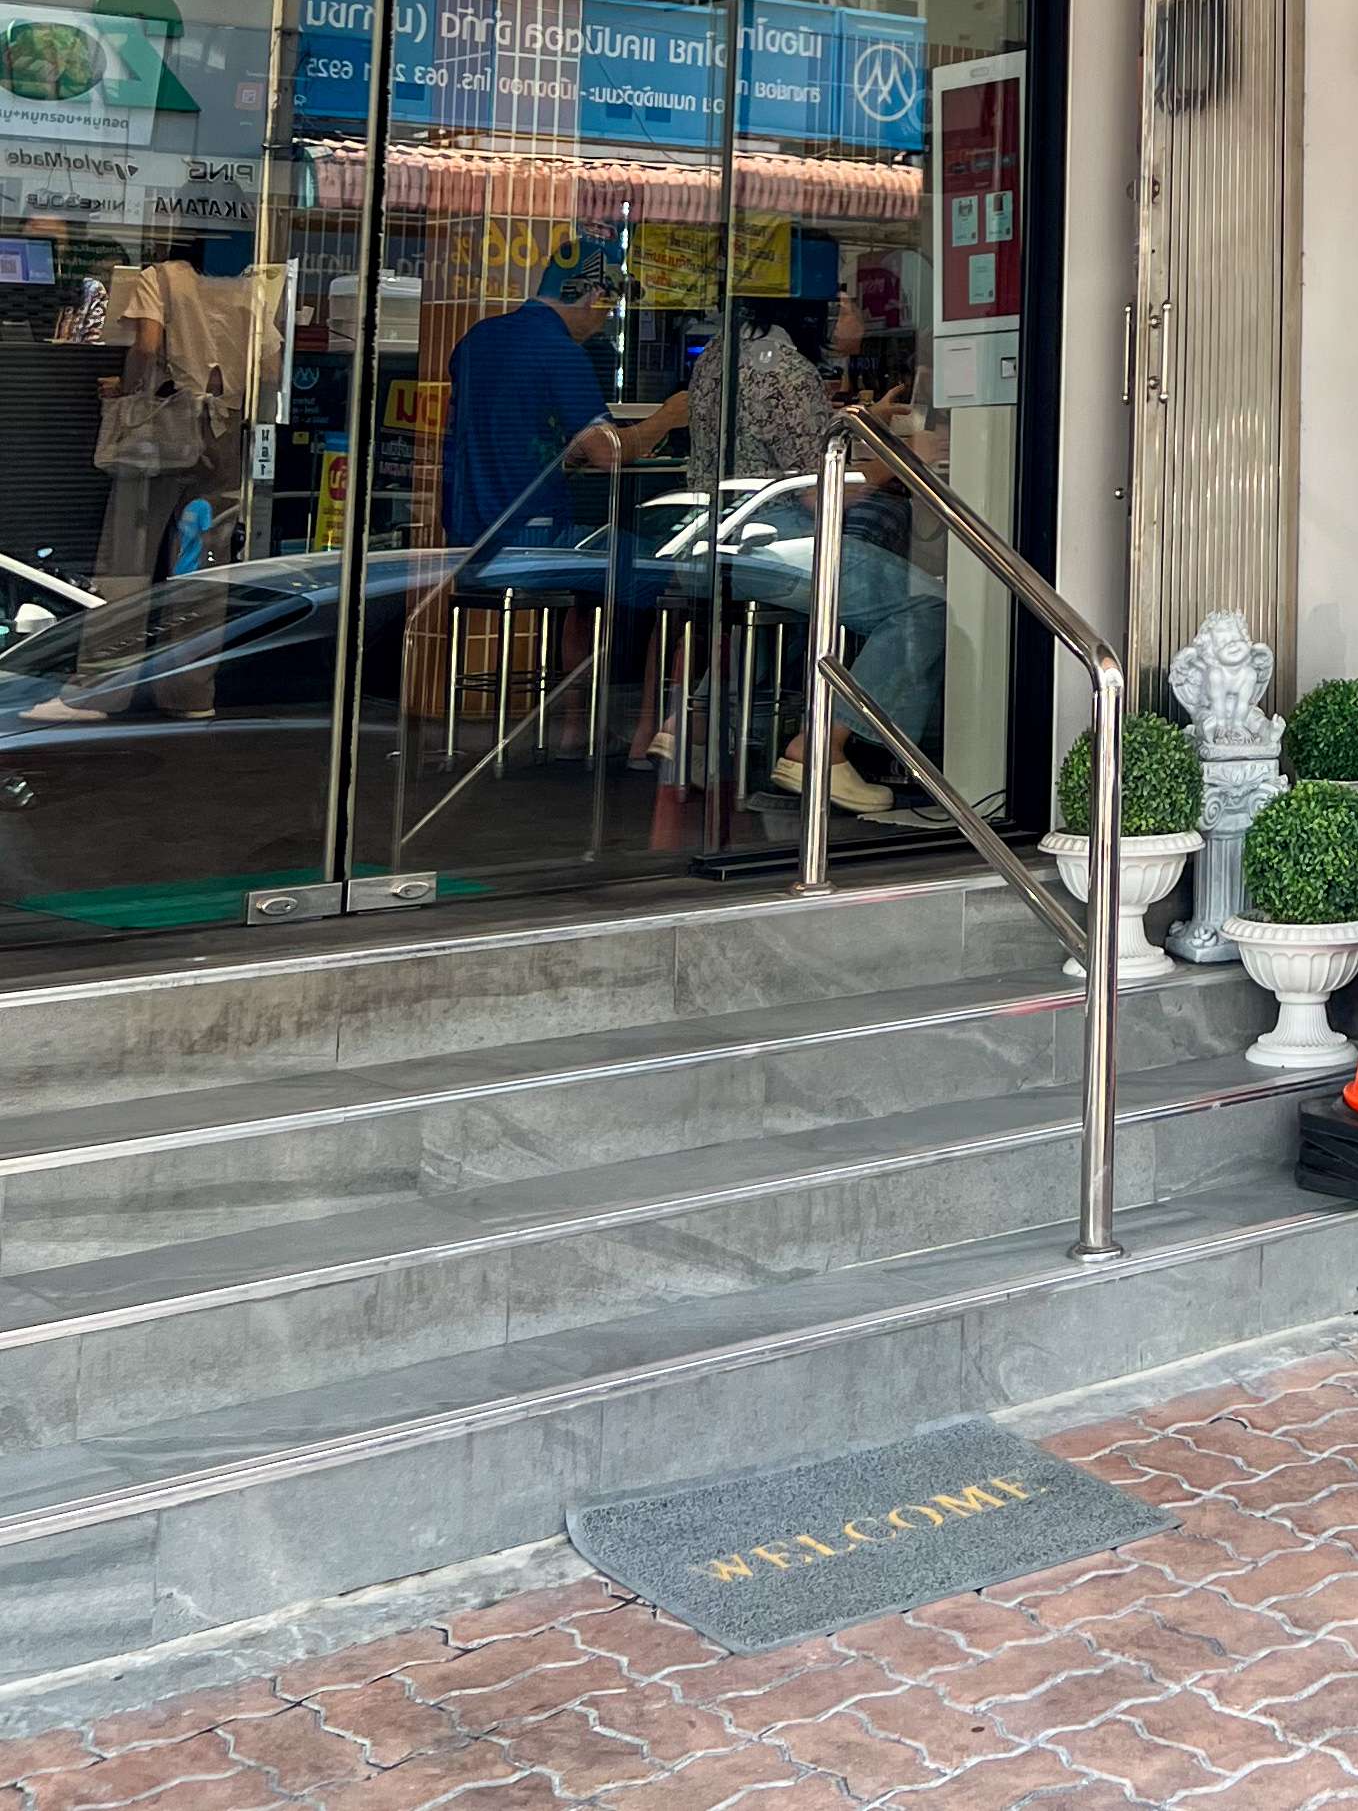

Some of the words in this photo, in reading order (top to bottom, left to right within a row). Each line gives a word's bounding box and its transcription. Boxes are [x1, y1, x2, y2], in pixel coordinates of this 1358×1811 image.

[0, 108, 130, 130] มู+หมูกรอบ+หมูทอด
[690, 1474, 1049, 1582] WELCOME
